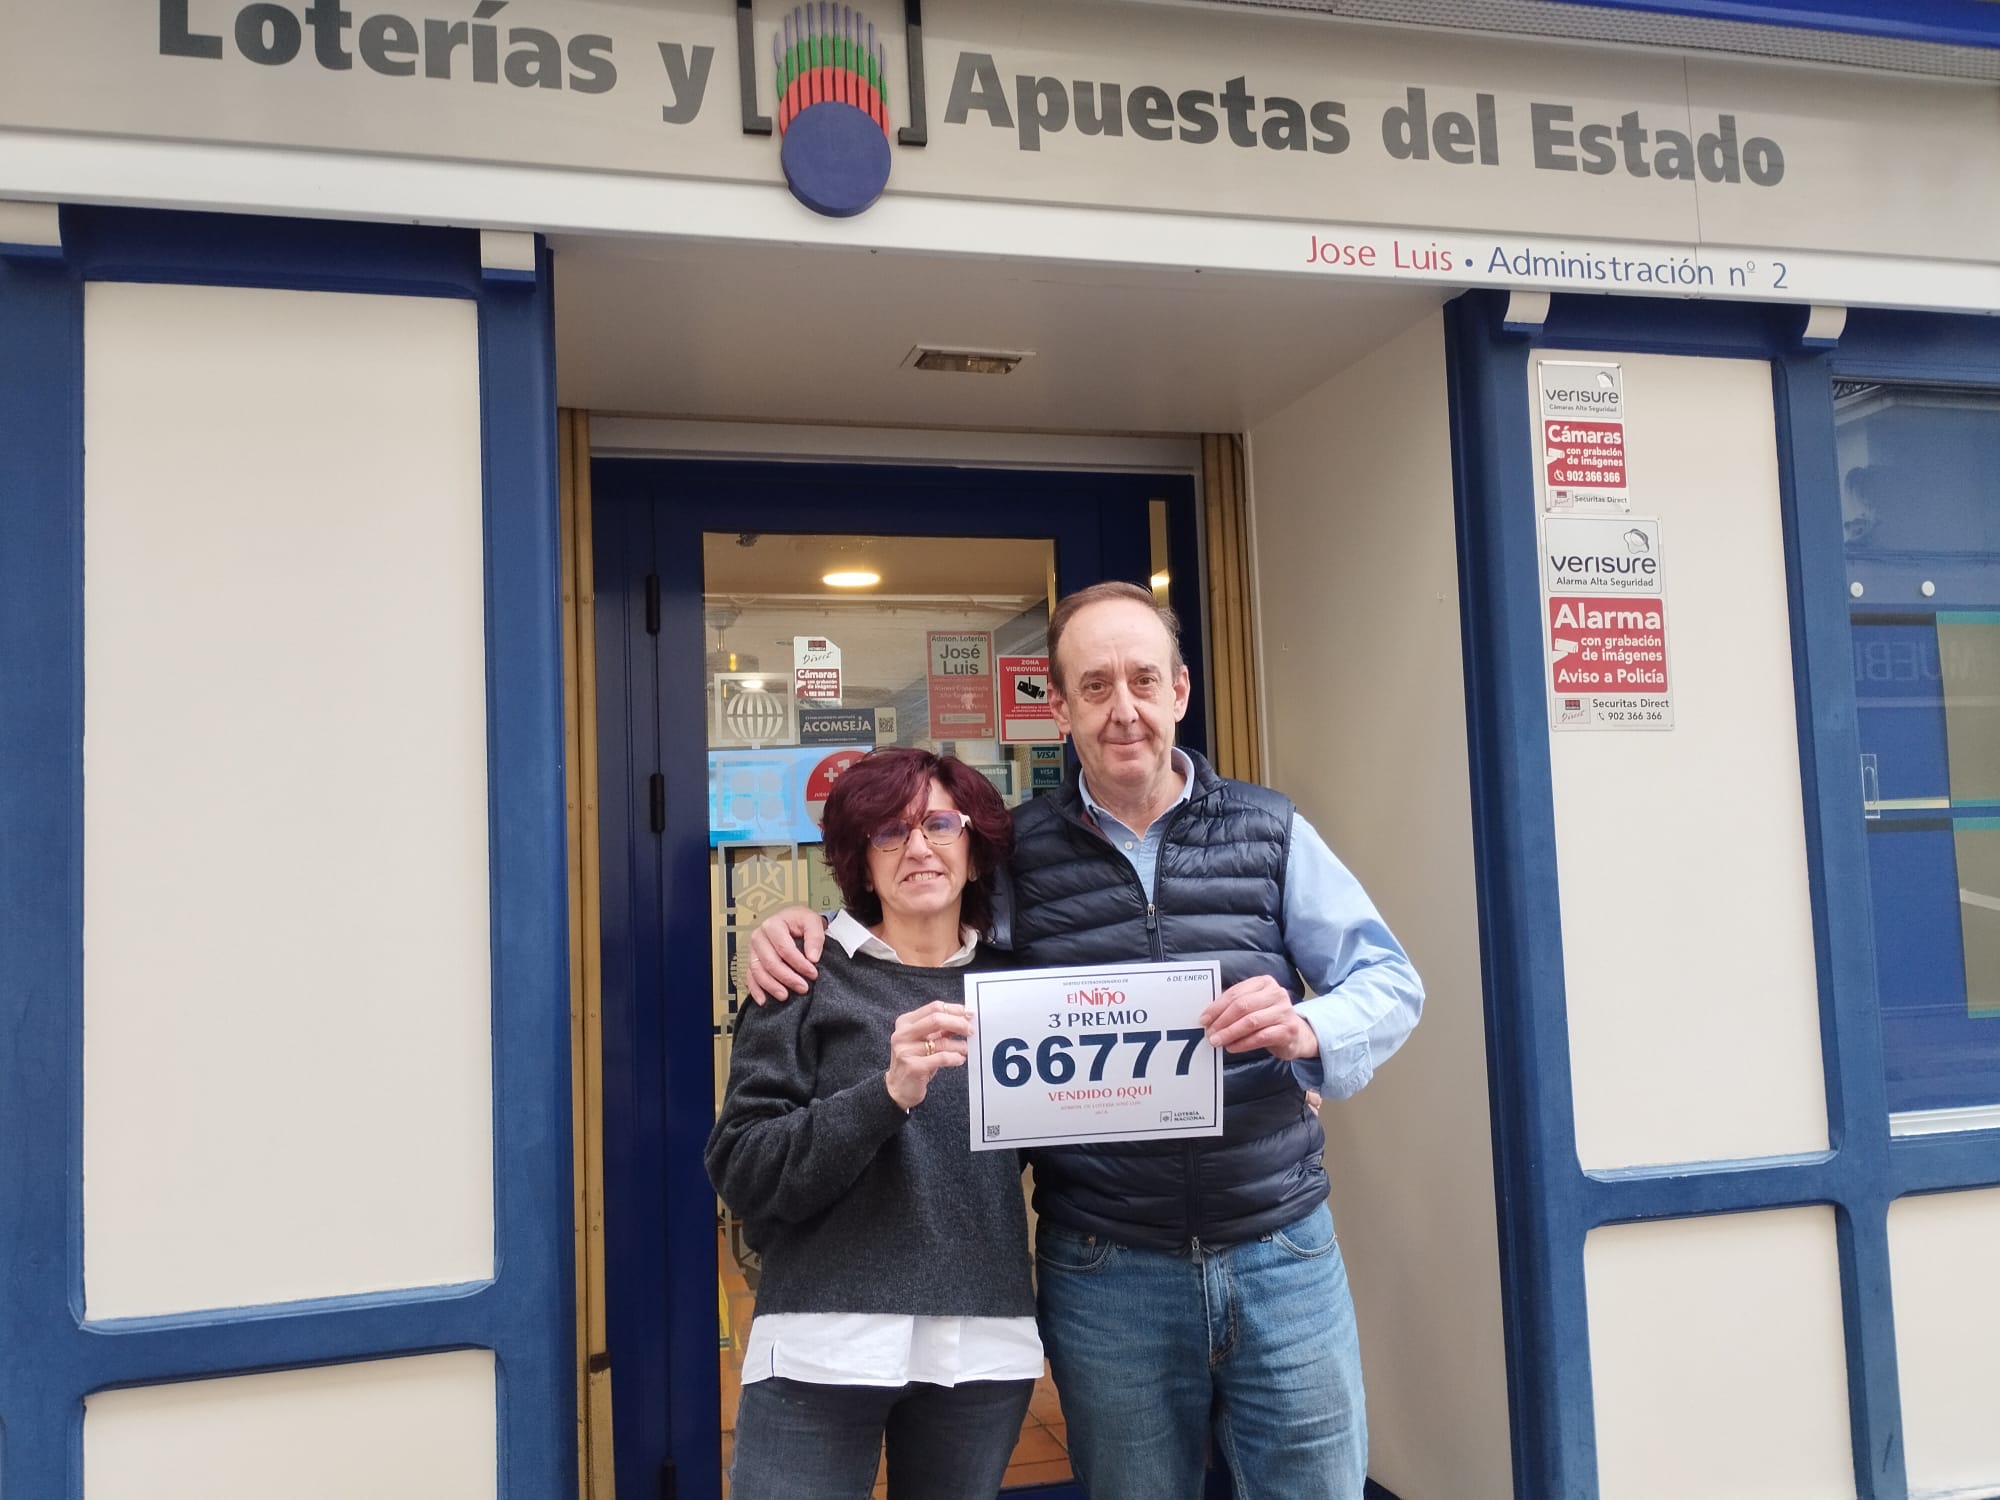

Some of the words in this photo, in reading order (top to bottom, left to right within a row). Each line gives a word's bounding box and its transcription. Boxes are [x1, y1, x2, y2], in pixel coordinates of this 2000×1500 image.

[158, 0, 618, 93] Loterías
[657, 41, 714, 125] y
[944, 51, 1350, 155] Apuestas
[1381, 87, 1500, 167] del
[1532, 102, 1785, 187] Estado
[1306, 235, 1376, 267] Jose
[1394, 240, 1453, 272] Luis
[1488, 246, 1714, 286] Administración
[1772, 262, 1789, 289] 2
[1545, 389, 1619, 404] verisure
[1548, 425, 1622, 445] Cámaras
[1566, 448, 1581, 456] con
[1583, 447, 1623, 458] grabación
[1567, 456, 1579, 466] de
[1581, 456, 1624, 468] imágenes
[1566, 471, 1583, 482] 902
[1585, 472, 1602, 482] 366
[1604, 472, 1621, 483] 366
[1575, 495, 1605, 503] Securitas
[1607, 496, 1627, 504] Direct
[1550, 555, 1657, 574] verisure
[1556, 577, 1587, 586] Alarma
[1590, 578, 1608, 586] Alta
[1610, 578, 1654, 589] Seguridad
[1554, 602, 1661, 630] Alarma
[1581, 636, 1602, 647] con
[1604, 634, 1662, 650] grabación
[939, 643, 981, 660] José
[1581, 649, 1598, 661] de
[1601, 649, 1663, 665] imágenes
[797, 669, 838, 679] Cámaras
[943, 660, 979, 675] Luis
[1557, 668, 1600, 684] Aviso
[1603, 672, 1613, 684] a
[1616, 667, 1665, 684] Policía
[1592, 698, 1637, 708] Securitas
[1640, 698, 1670, 708] Direct
[1608, 712, 1625, 721] 902
[1627, 712, 1644, 721] 366
[1646, 712, 1662, 721] 366
[1036, 751, 1056, 759] VISA
[1184, 974, 1209, 982] ENERO
[1067, 991, 1078, 1004] El
[1079, 986, 1126, 1007] Niño
[1068, 1008, 1148, 1028] PREMIO
[991, 1028, 1205, 1088] 66777
[1048, 1087, 1112, 1102] VENDIDO
